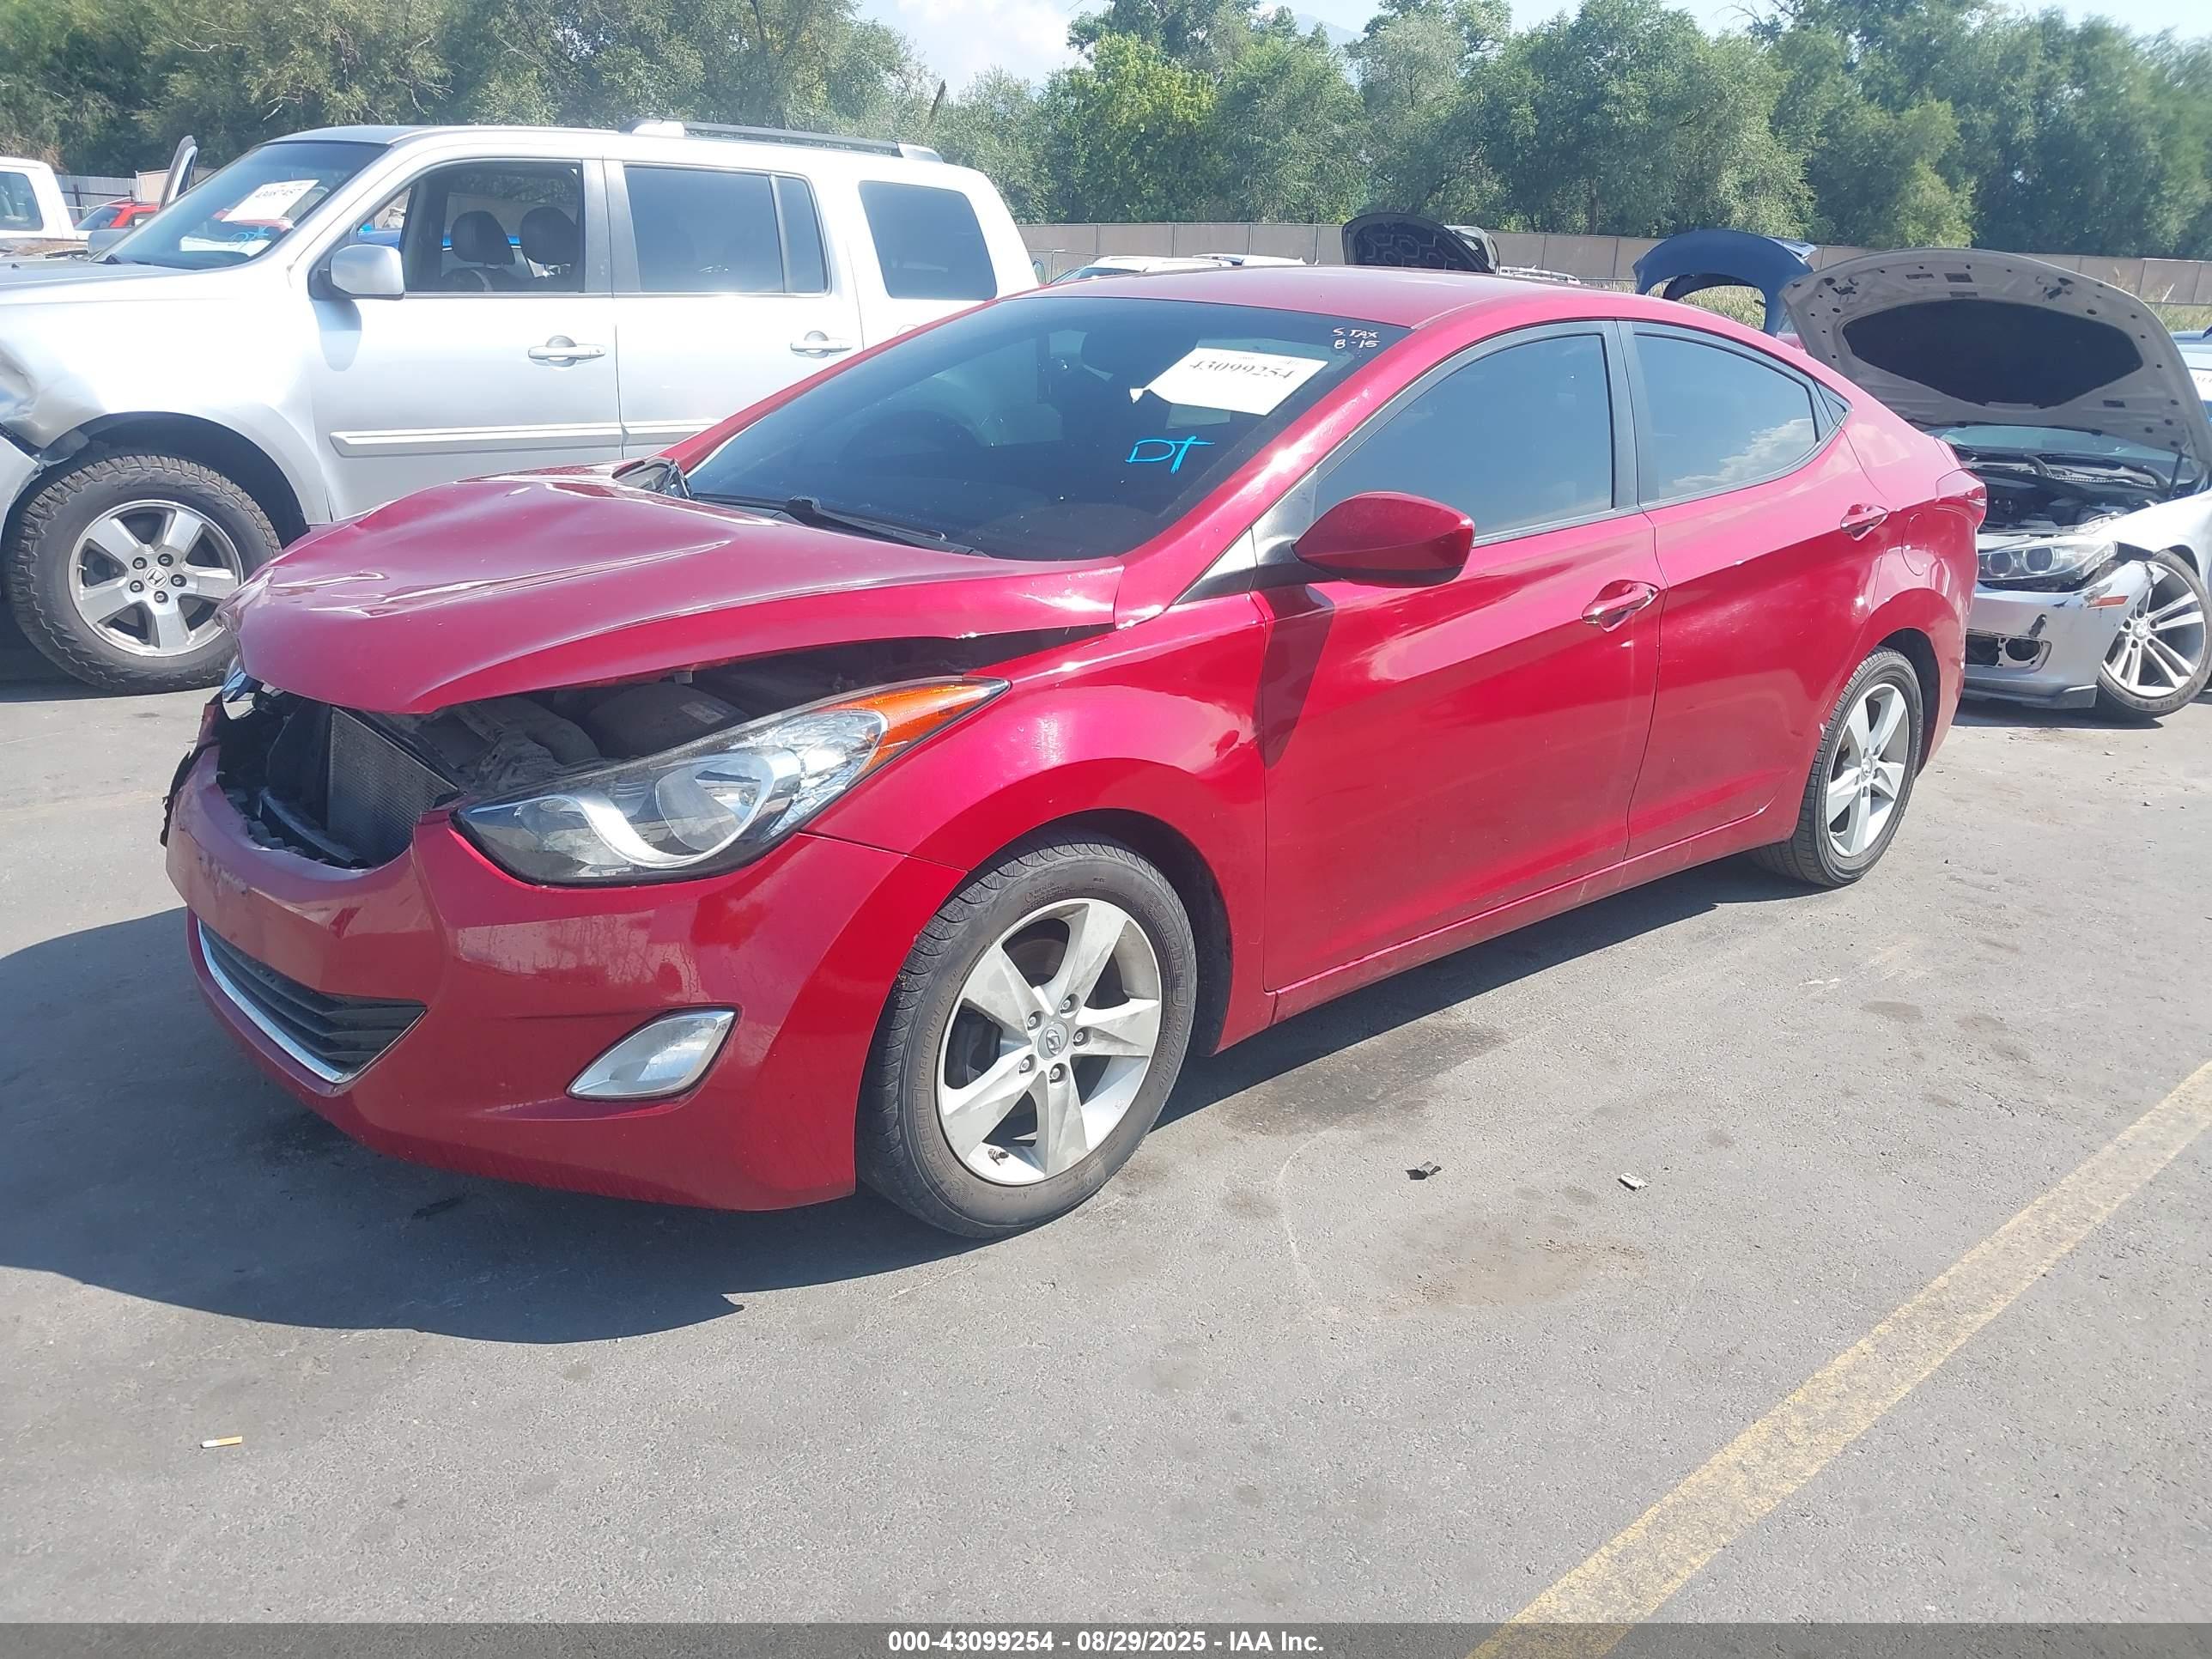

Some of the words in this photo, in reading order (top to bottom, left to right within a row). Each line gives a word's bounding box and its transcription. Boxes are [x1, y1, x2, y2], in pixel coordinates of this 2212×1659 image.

[1349, 329, 1380, 339] TAX
[1188, 361, 1296, 379] 43099254
[1126, 435, 1215, 474] DT
